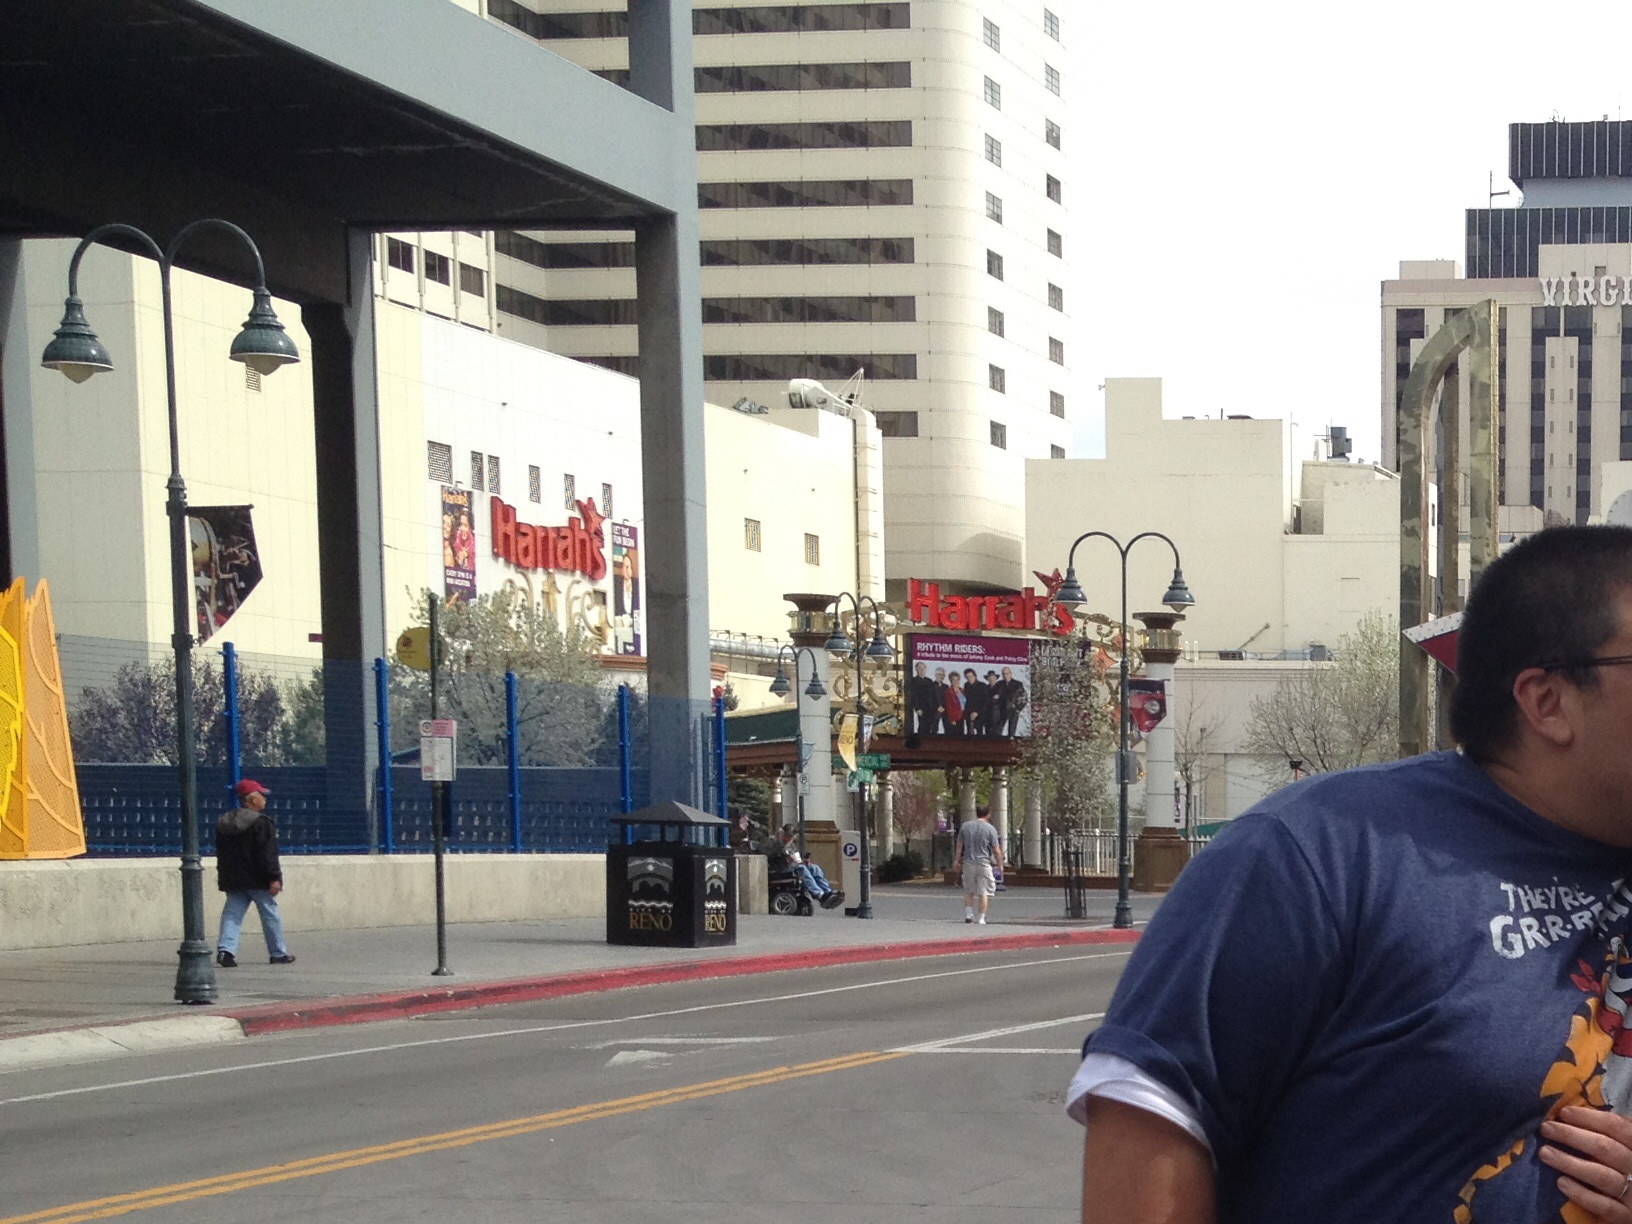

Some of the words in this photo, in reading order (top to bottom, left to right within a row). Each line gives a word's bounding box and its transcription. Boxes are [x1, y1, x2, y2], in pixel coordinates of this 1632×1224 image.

[490, 496, 607, 581] Harrah's
[906, 576, 1075, 636] Harrah's
[917, 642, 952, 653] RHYTHM
[954, 645, 986, 654] RIDERS:
[1500, 876, 1596, 913] THEY'RE
[629, 912, 673, 931] RENO
[704, 914, 727, 932] RENO
